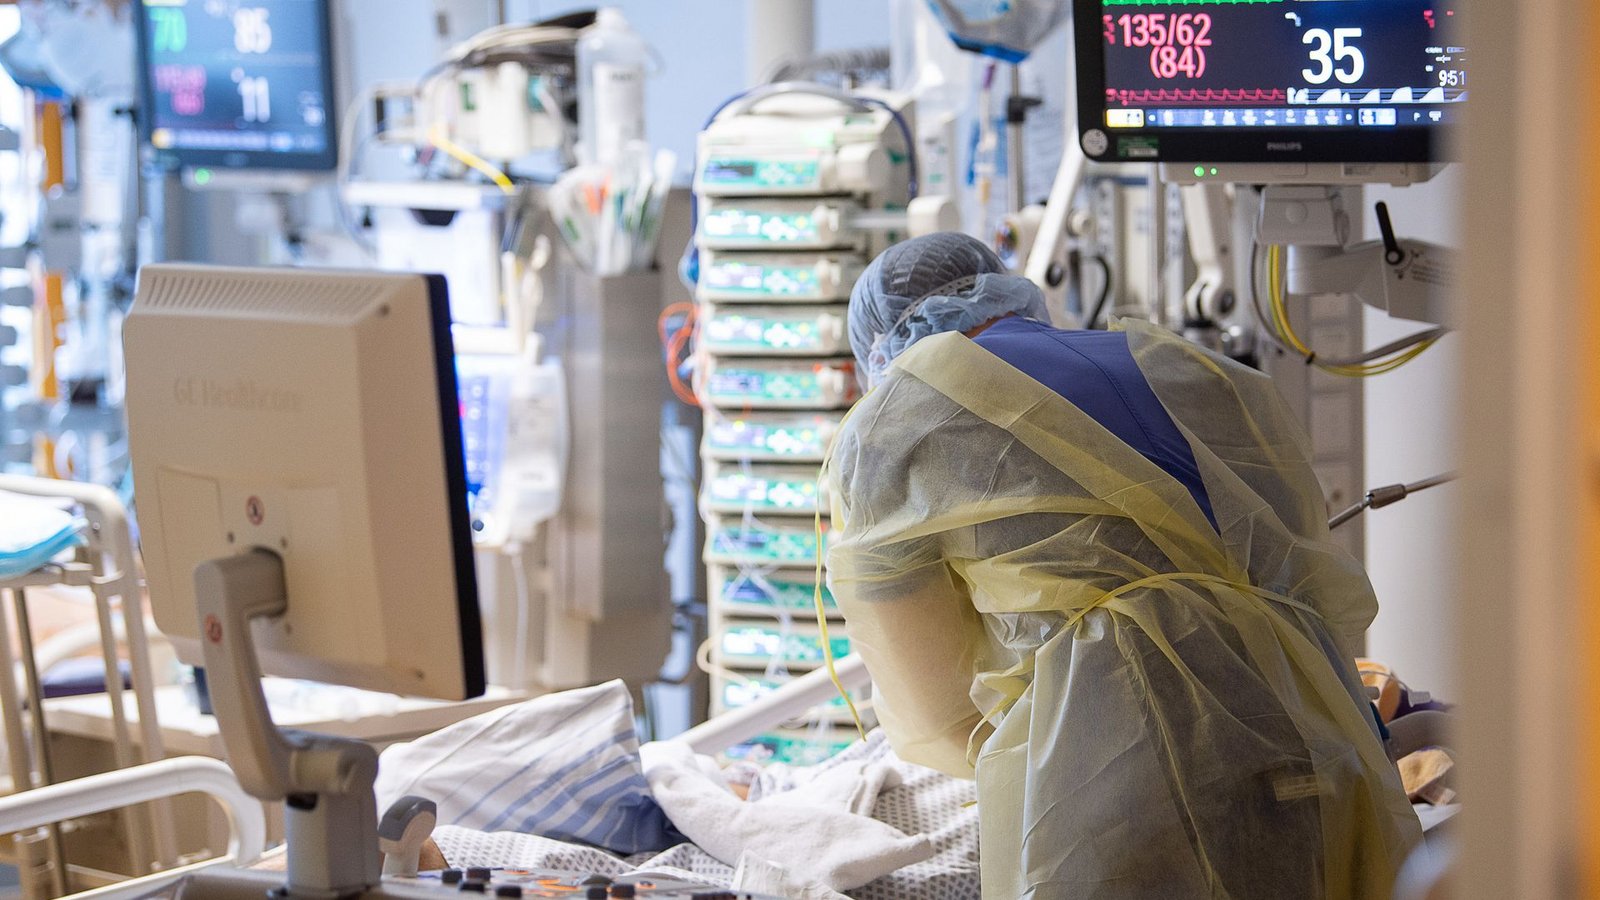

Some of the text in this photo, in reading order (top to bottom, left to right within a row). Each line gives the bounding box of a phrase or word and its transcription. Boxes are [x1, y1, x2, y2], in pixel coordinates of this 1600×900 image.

[1117, 13, 1212, 47] 135/62
[1149, 45, 1206, 78] (84)
[1302, 27, 1364, 84] 35
[1438, 69, 1465, 87] 9:51
